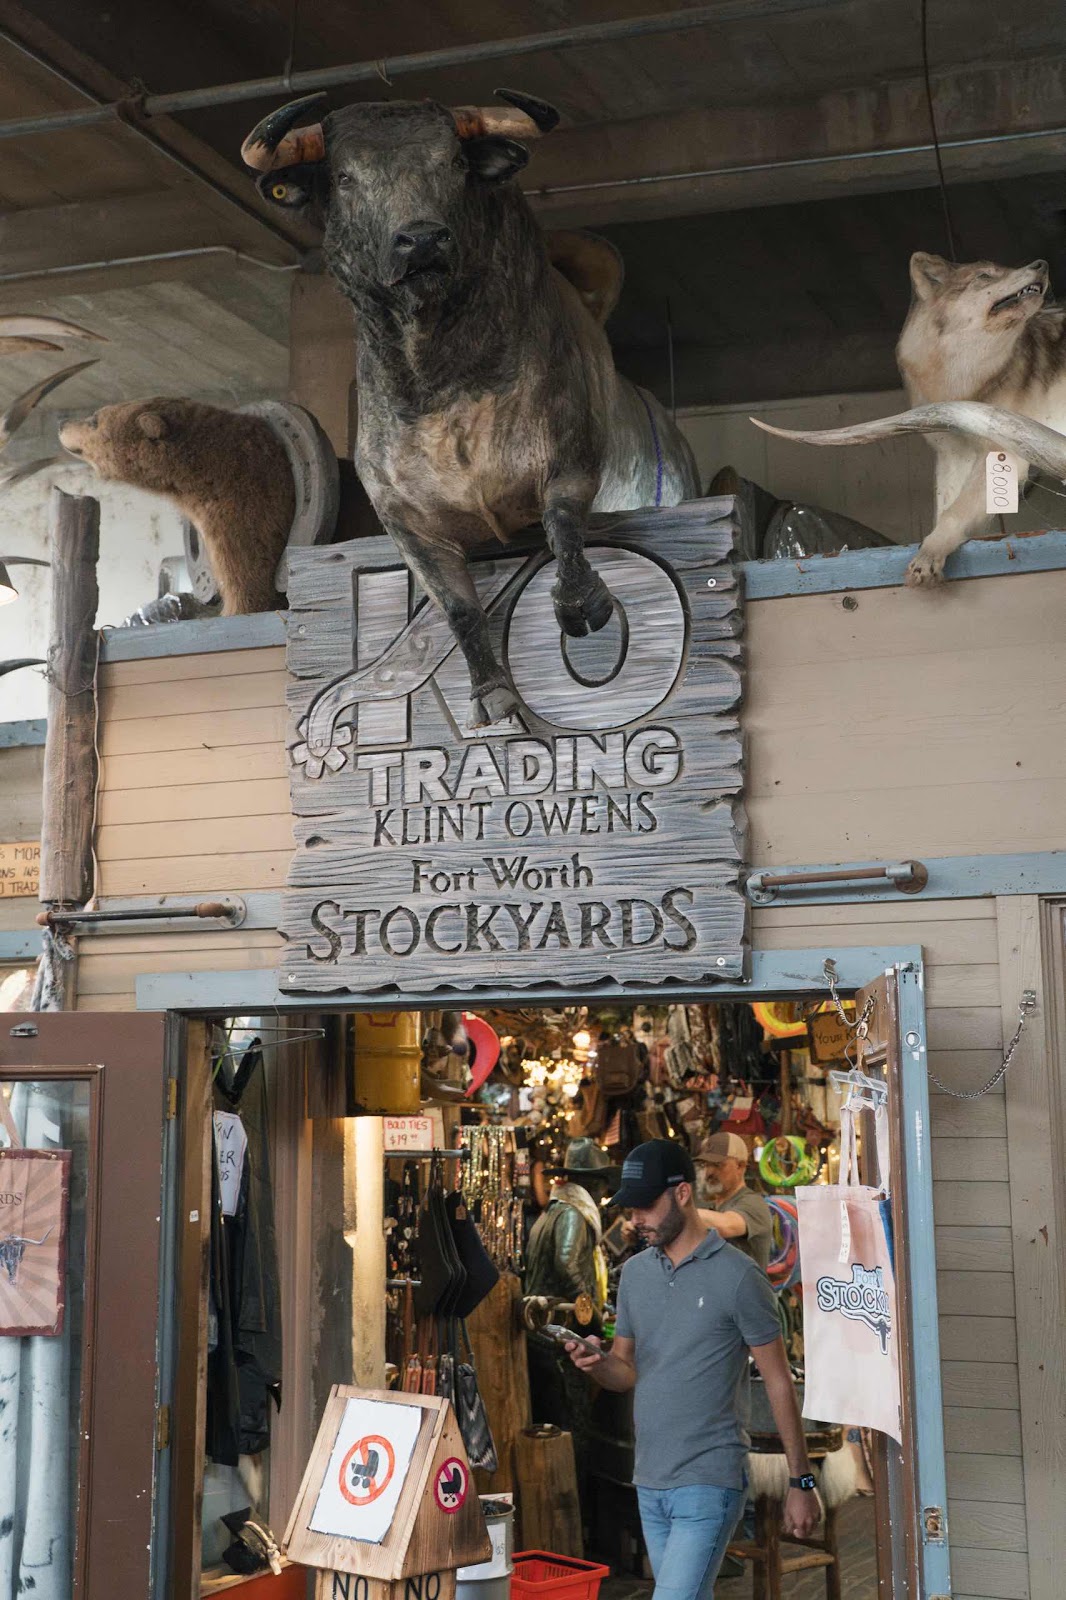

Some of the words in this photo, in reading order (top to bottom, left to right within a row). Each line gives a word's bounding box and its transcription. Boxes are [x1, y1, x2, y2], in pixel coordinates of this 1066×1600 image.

[990, 463, 1012, 507] 8,000
[356, 726, 684, 808] TRADING
[373, 801, 493, 848] KLINT
[504, 791, 658, 839] OWENS
[411, 859, 479, 894] Fort
[482, 852, 594, 891] Worth
[306, 887, 698, 964] STOCKYARDS
[408, 1120, 428, 1130] TIES
[332, 1571, 369, 1600] NO
[404, 1572, 440, 1600] NO
